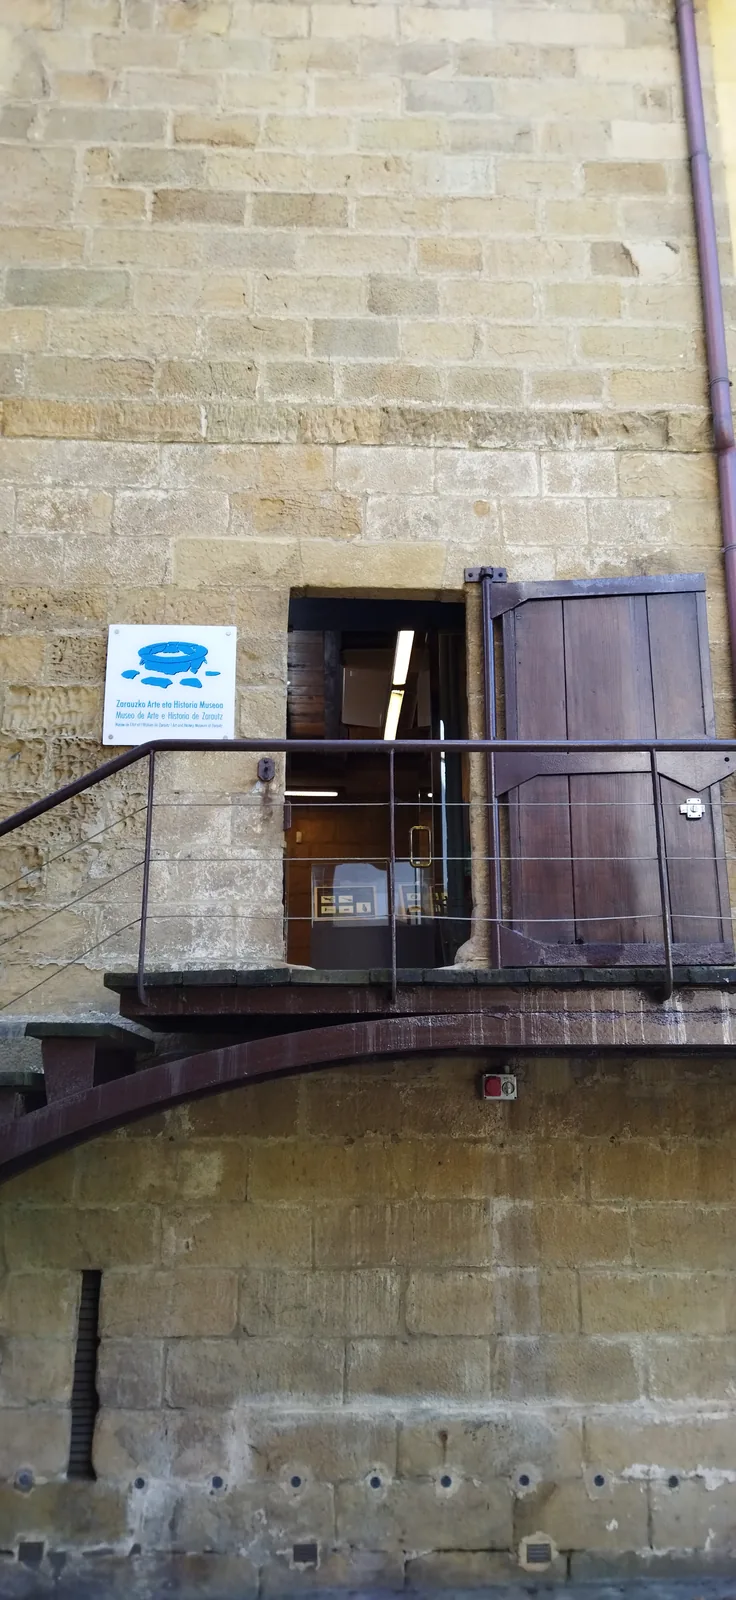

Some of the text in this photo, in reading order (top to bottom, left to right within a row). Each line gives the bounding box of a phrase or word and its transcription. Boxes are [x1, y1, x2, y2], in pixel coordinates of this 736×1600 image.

[116, 699, 146, 708] Zarauzko
[147, 700, 160, 708] Arte
[174, 700, 198, 709] Historia
[199, 700, 224, 710] Museoa
[116, 711, 134, 720] Museo
[138, 710, 144, 720] de
[147, 712, 158, 720] Arte
[168, 712, 190, 720] Historia
[192, 712, 199, 720] de
[202, 712, 224, 720] Zarautz
